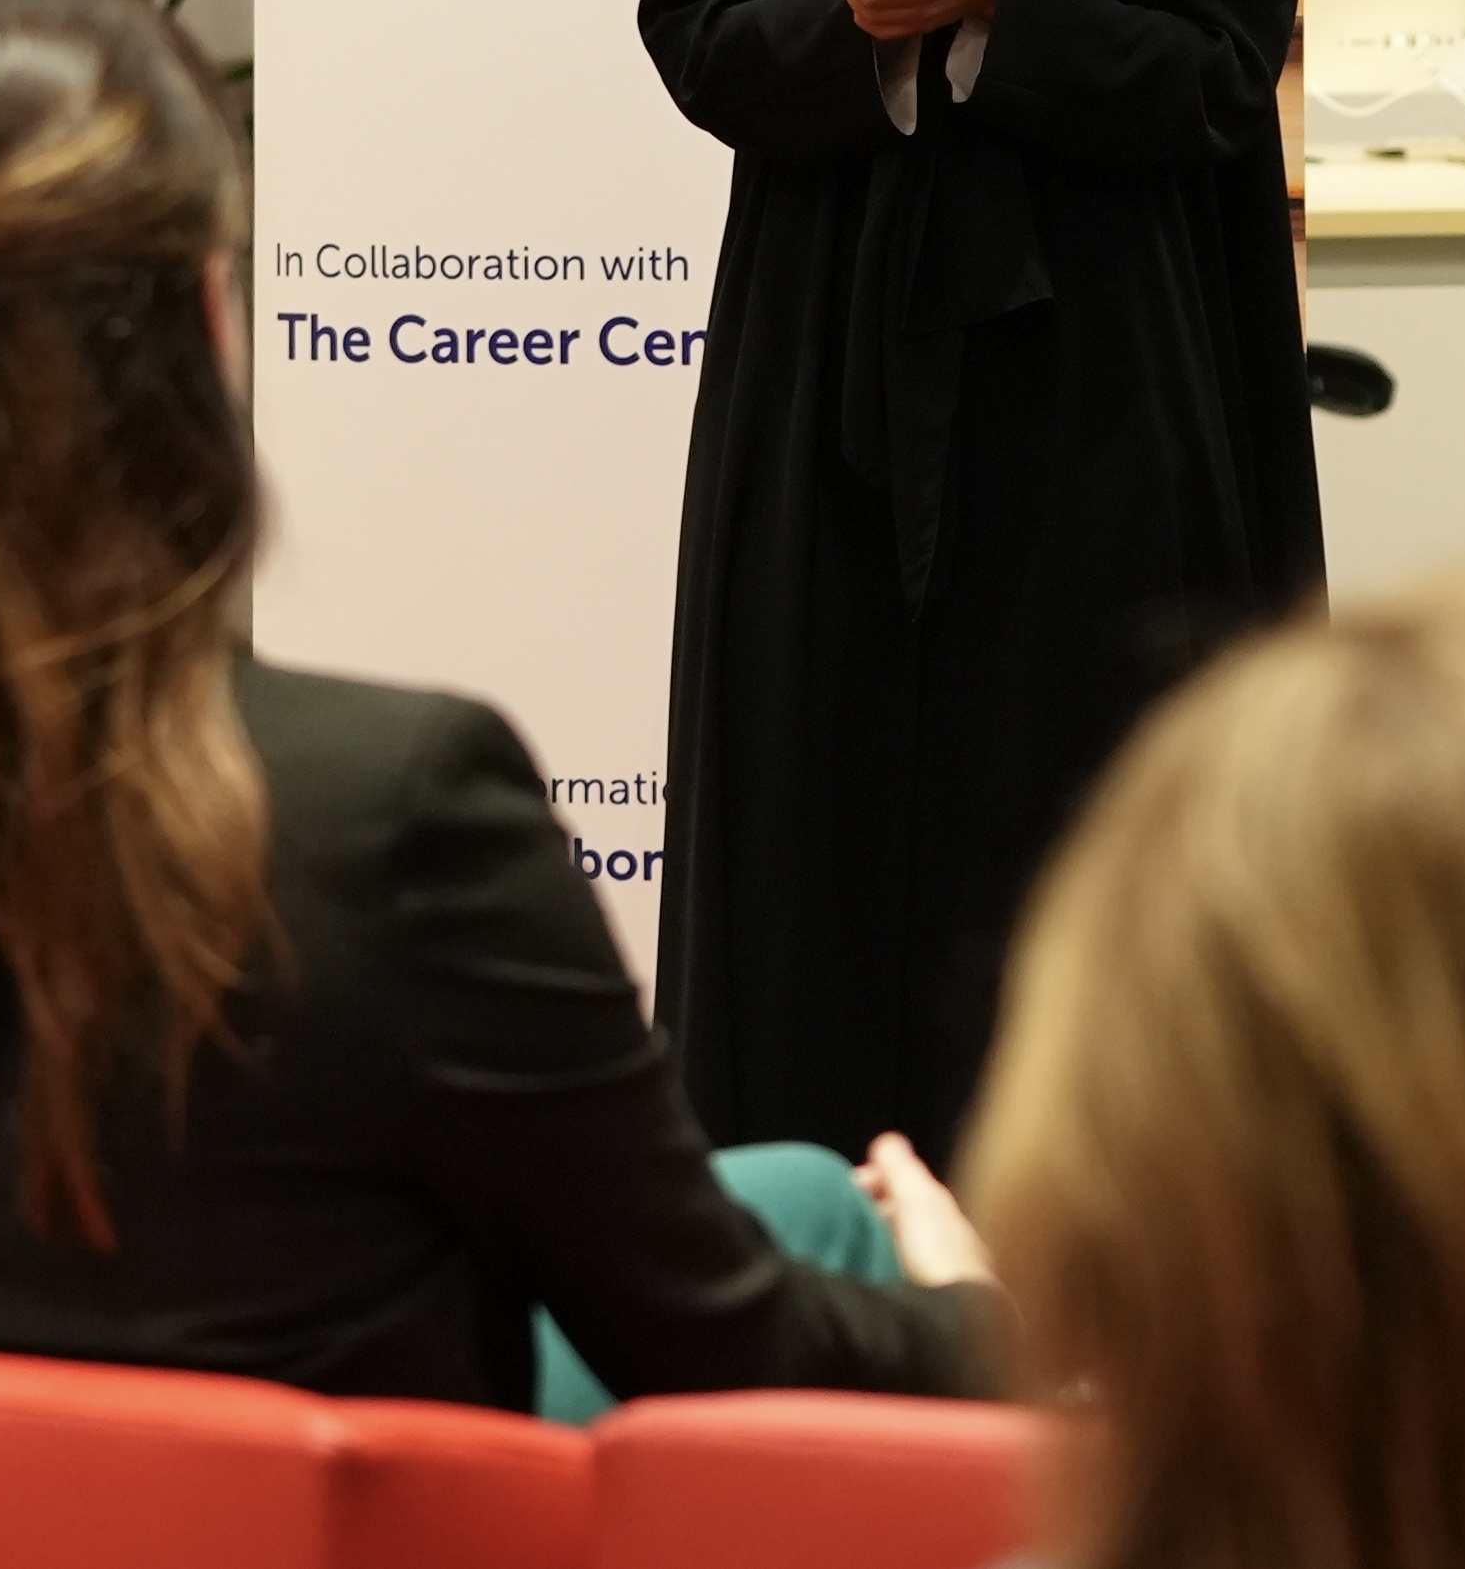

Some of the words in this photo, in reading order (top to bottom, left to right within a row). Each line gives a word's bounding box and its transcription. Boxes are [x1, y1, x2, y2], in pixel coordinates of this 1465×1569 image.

[276, 243, 303, 278] In
[316, 243, 585, 281] Collaboration
[600, 246, 689, 281] with
[276, 312, 371, 363] The
[388, 313, 581, 366] Career
